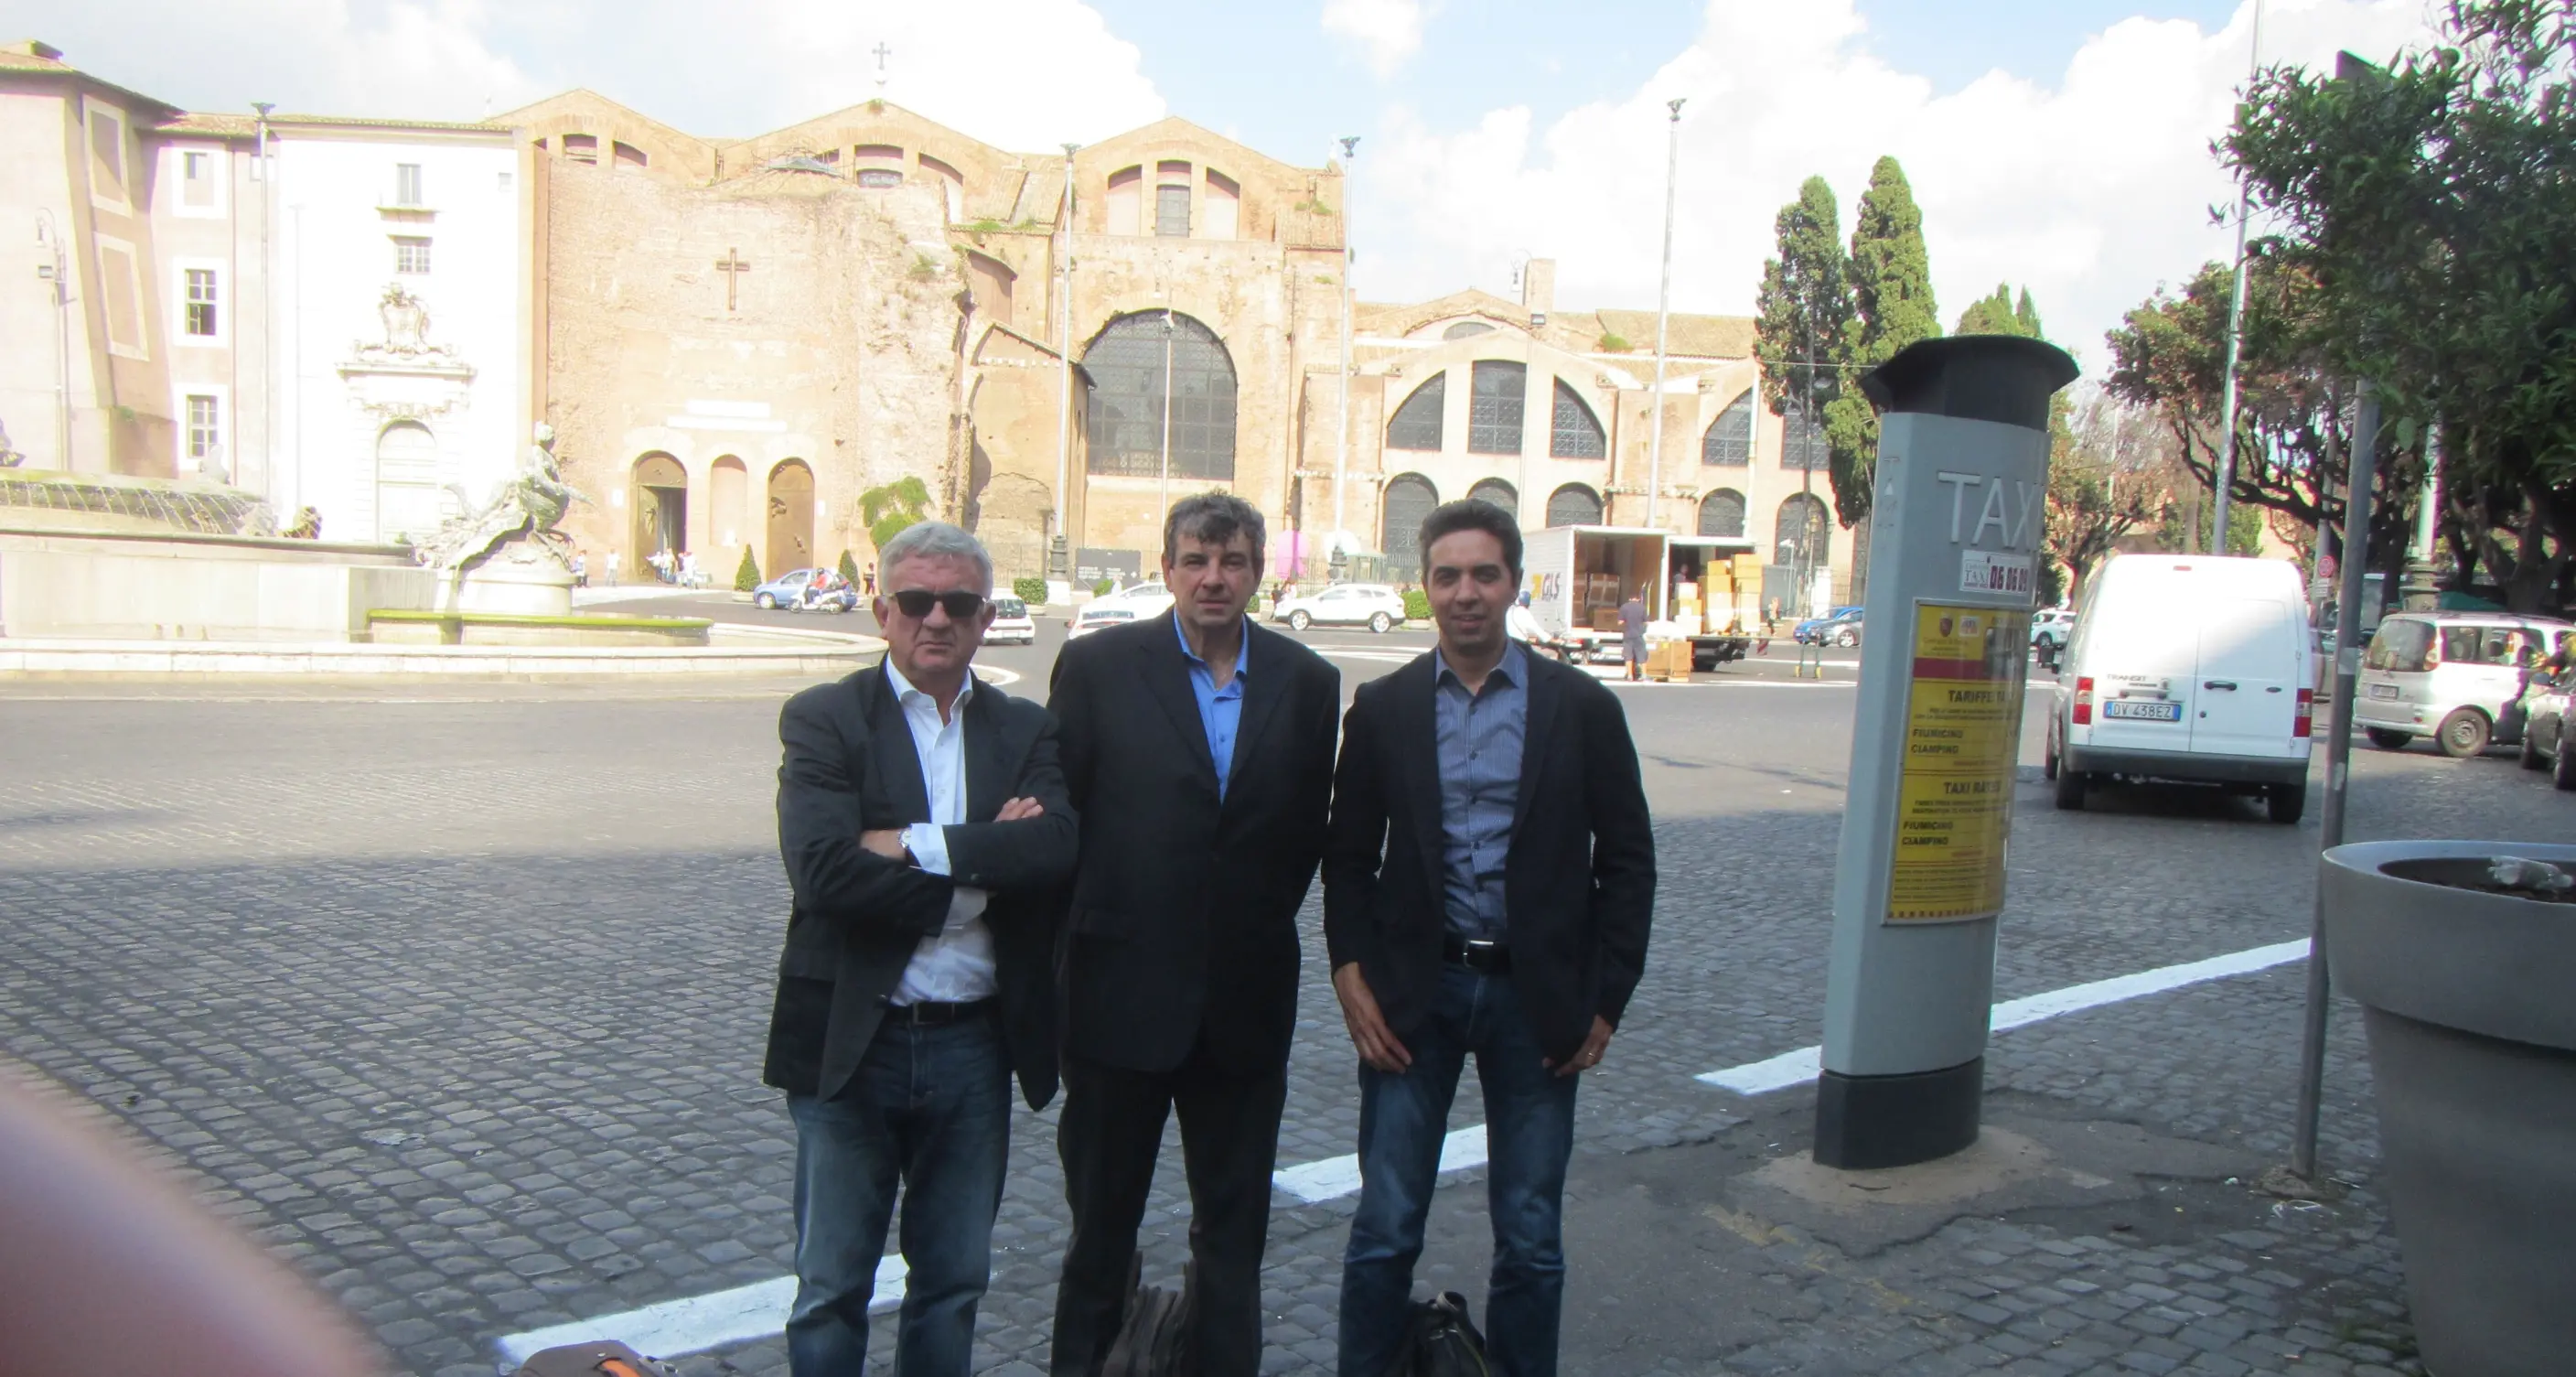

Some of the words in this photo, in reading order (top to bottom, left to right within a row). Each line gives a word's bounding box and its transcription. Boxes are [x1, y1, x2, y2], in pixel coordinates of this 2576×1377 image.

[1541, 573, 1561, 600] GLS
[1948, 690, 1994, 704] TARIFFE
[1912, 728, 1963, 738] FIUMICINO
[1911, 744, 1959, 754] CIAMPINO
[1944, 781, 1970, 794] TAXI
[1903, 821, 1953, 830] FIUMICINO
[1902, 836, 1948, 845] CIAMPINO
